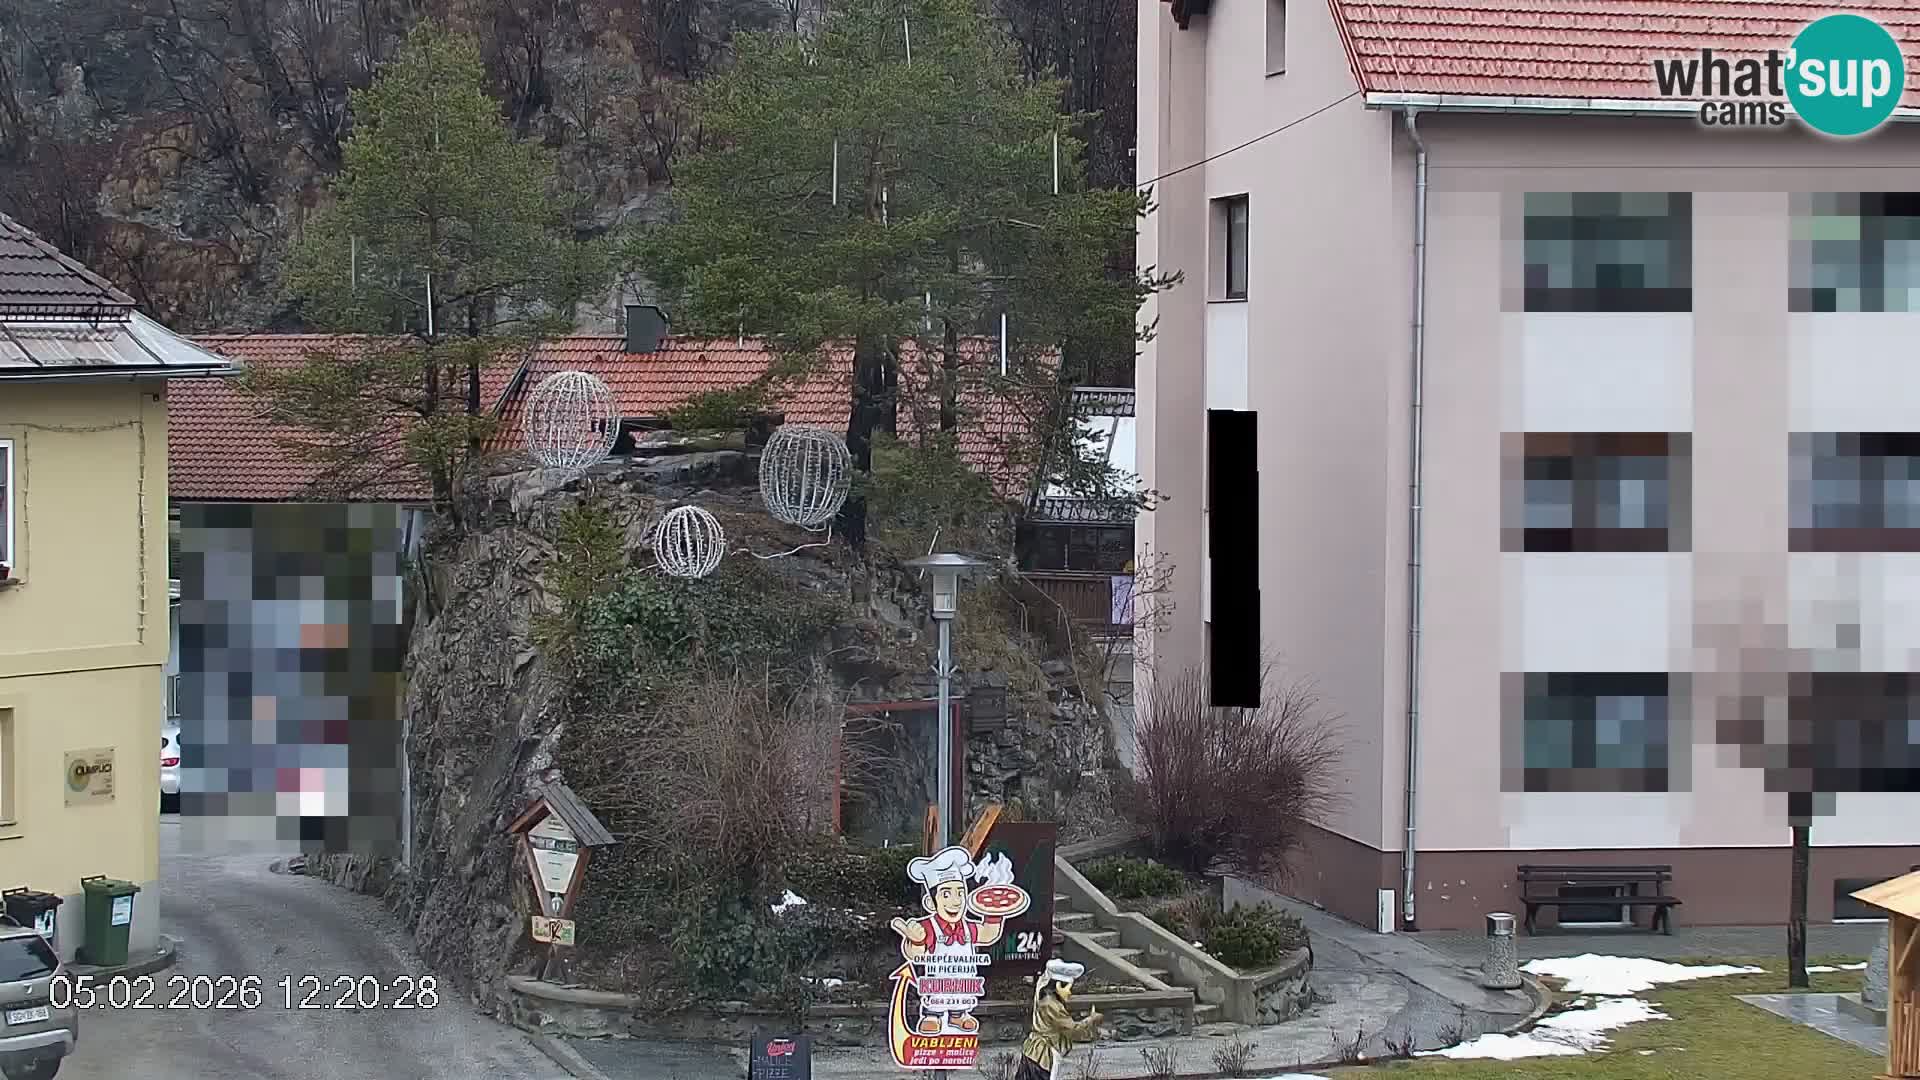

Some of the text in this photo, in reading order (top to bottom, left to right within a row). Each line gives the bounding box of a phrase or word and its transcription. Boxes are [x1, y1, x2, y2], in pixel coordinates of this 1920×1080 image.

[927, 965, 976, 973] IN PICERIJA
[911, 1037, 978, 1048] VABLJENI
